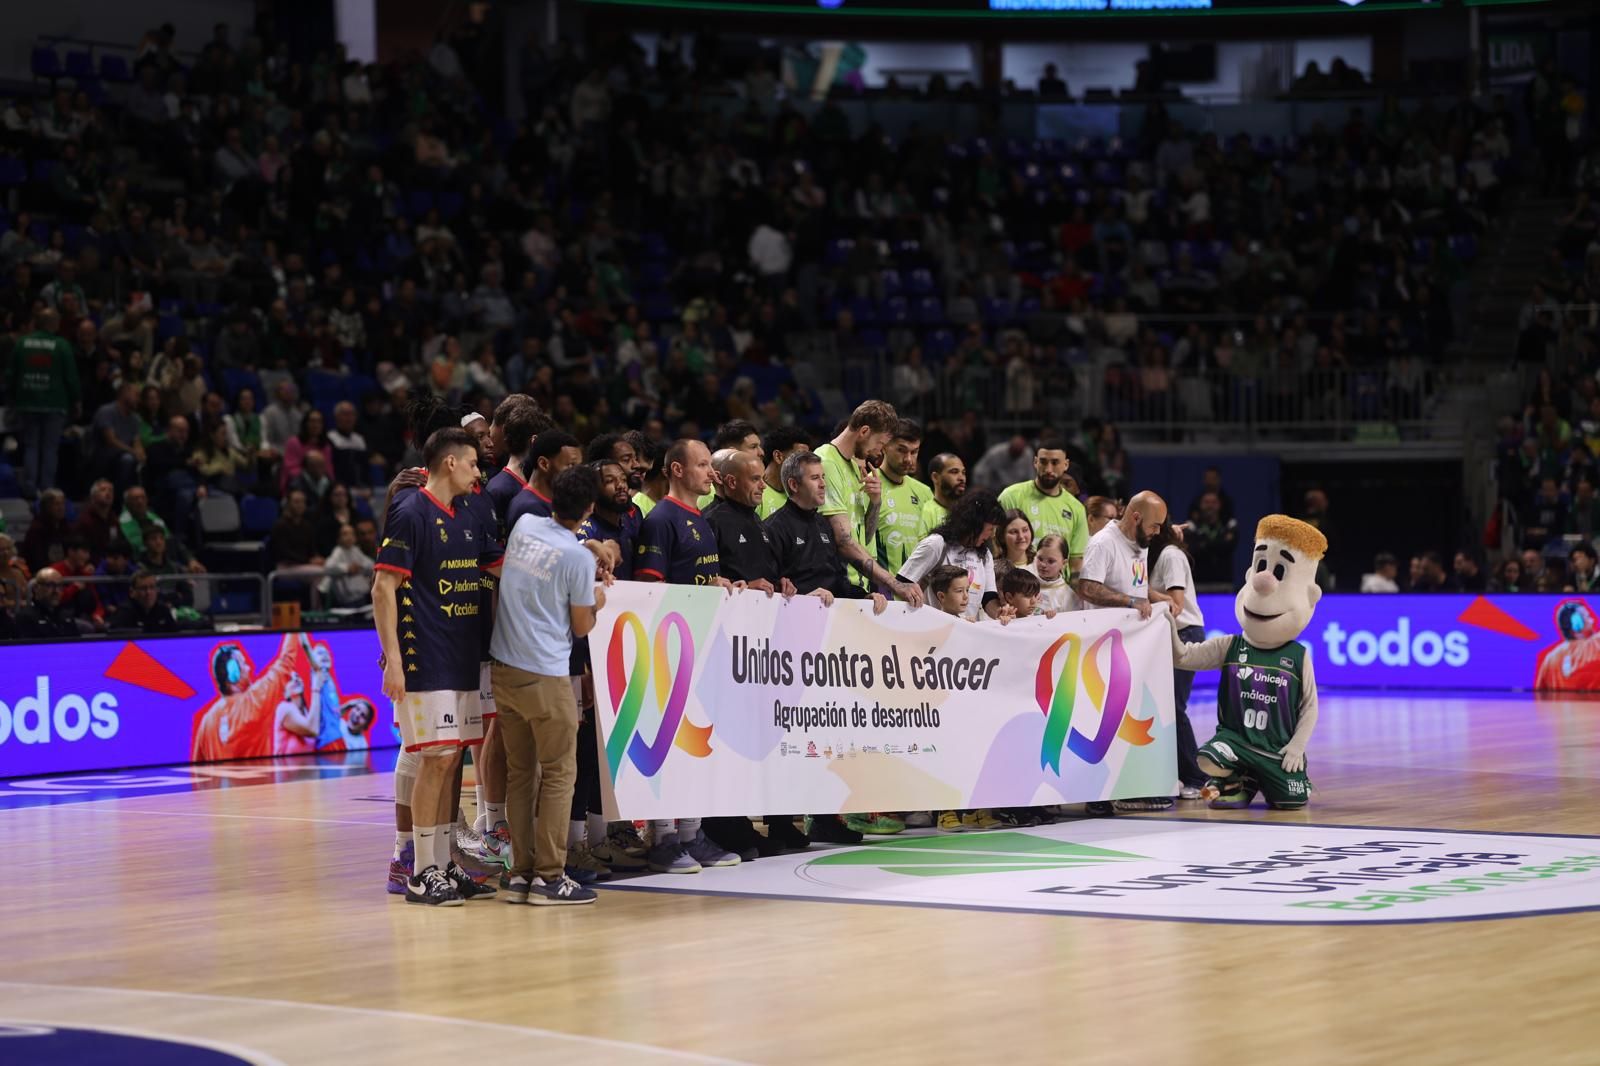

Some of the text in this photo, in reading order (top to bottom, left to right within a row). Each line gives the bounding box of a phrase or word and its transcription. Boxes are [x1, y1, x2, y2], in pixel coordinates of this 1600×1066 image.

[732, 635, 1000, 690] Unidos contra el cáncer
[1323, 617, 1469, 667] todos
[1254, 673, 1288, 687] Unicaja
[774, 699, 940, 733] Agrupación de desarrollo
[1243, 708, 1268, 730] 00
[1029, 840, 1445, 897] Fundación
[1217, 852, 1530, 895] Unicaja
[1284, 855, 1600, 911] Baloncest
